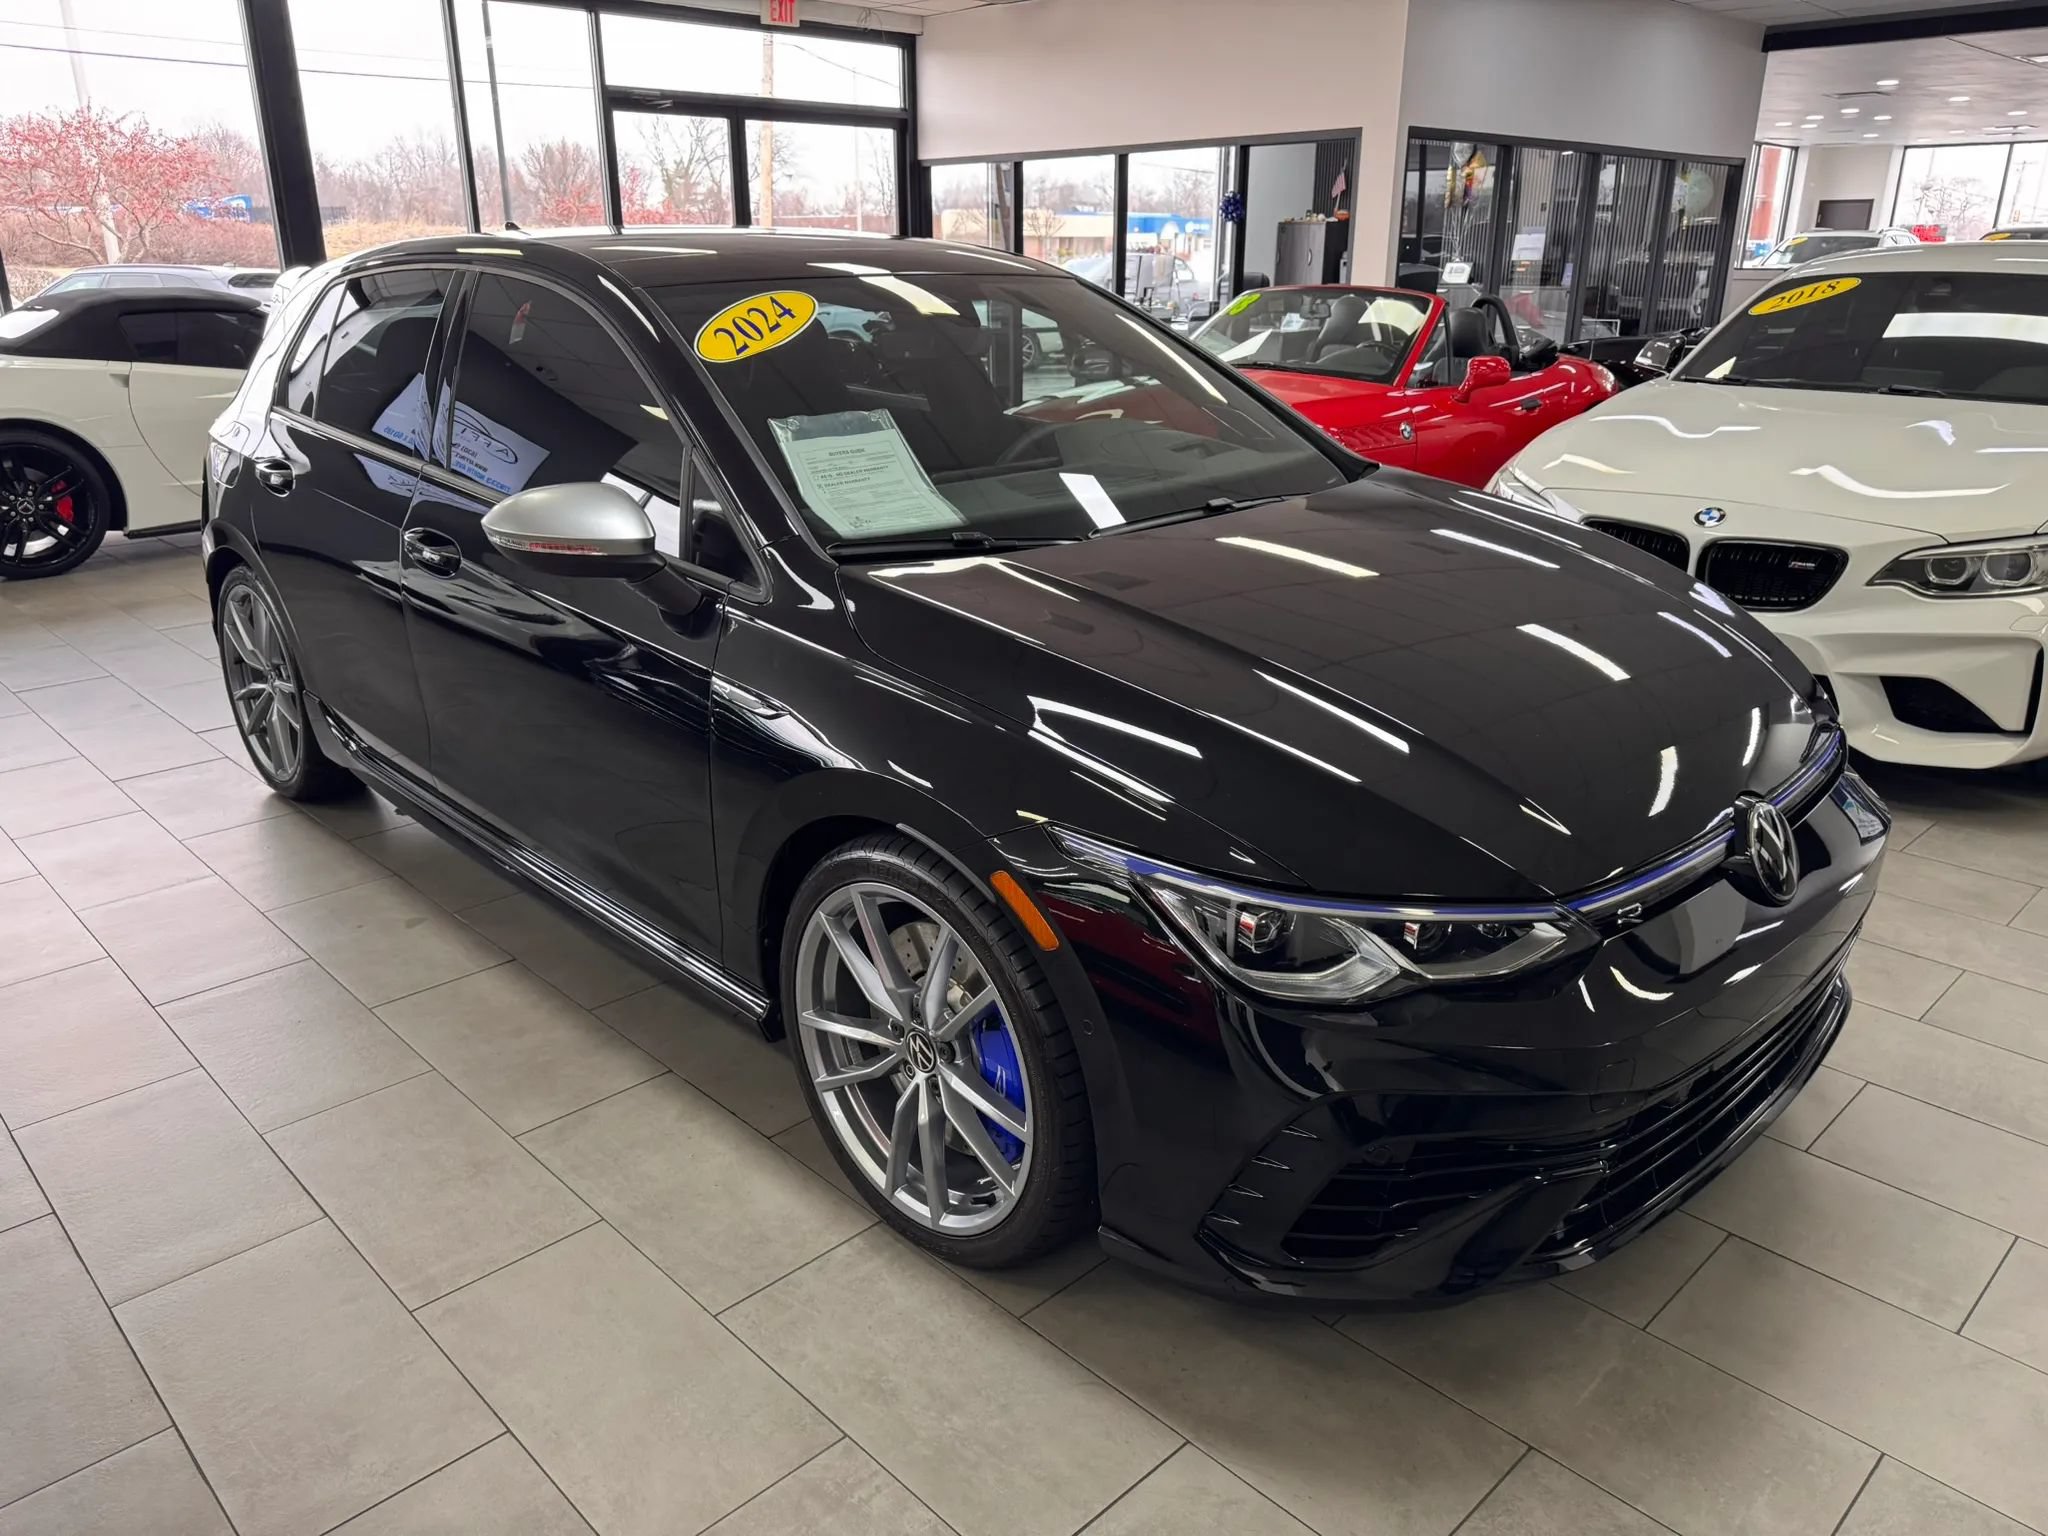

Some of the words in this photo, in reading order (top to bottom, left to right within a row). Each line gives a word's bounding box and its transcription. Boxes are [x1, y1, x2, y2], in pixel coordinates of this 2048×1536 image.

[769, 0, 796, 23] EXIT
[1767, 281, 1841, 310] 2018
[713, 296, 797, 356] 2024
